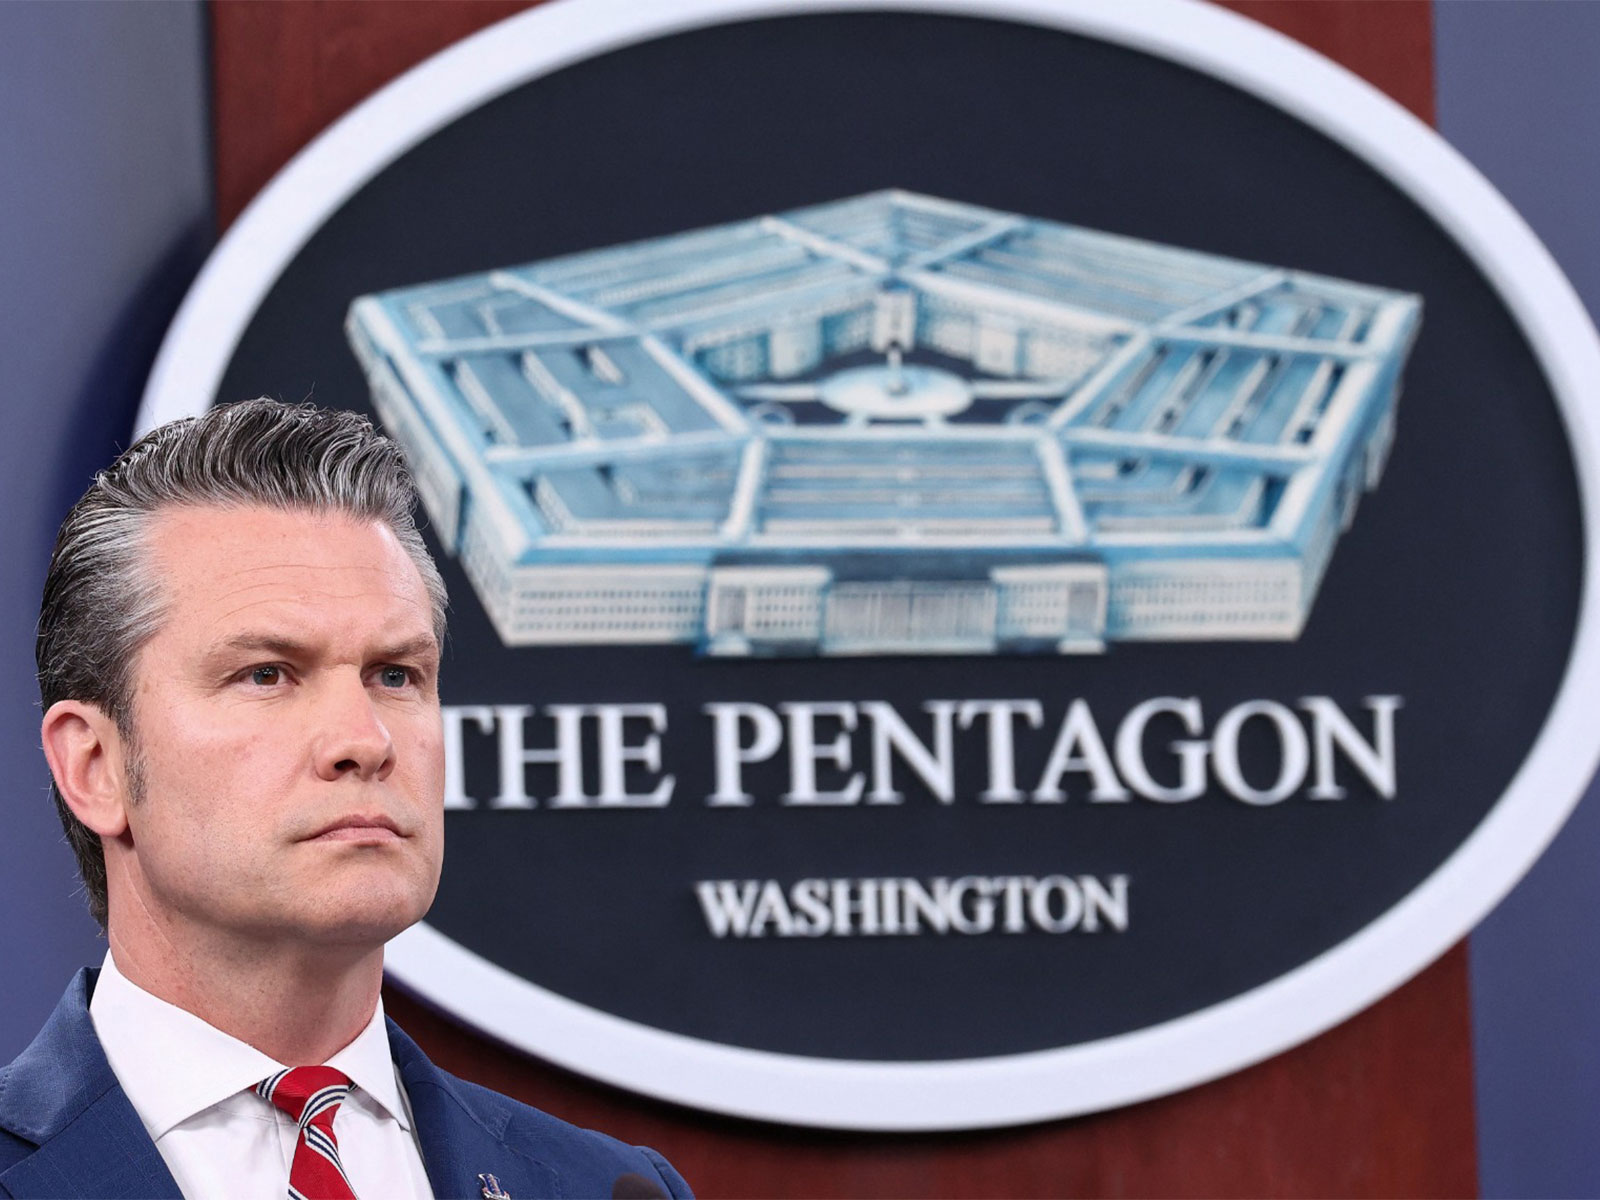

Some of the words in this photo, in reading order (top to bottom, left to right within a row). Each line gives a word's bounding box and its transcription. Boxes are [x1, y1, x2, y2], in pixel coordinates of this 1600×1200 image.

[441, 703, 676, 809] THE
[705, 696, 1402, 805] PENTAGON
[696, 875, 1129, 937] WASHINGTON
